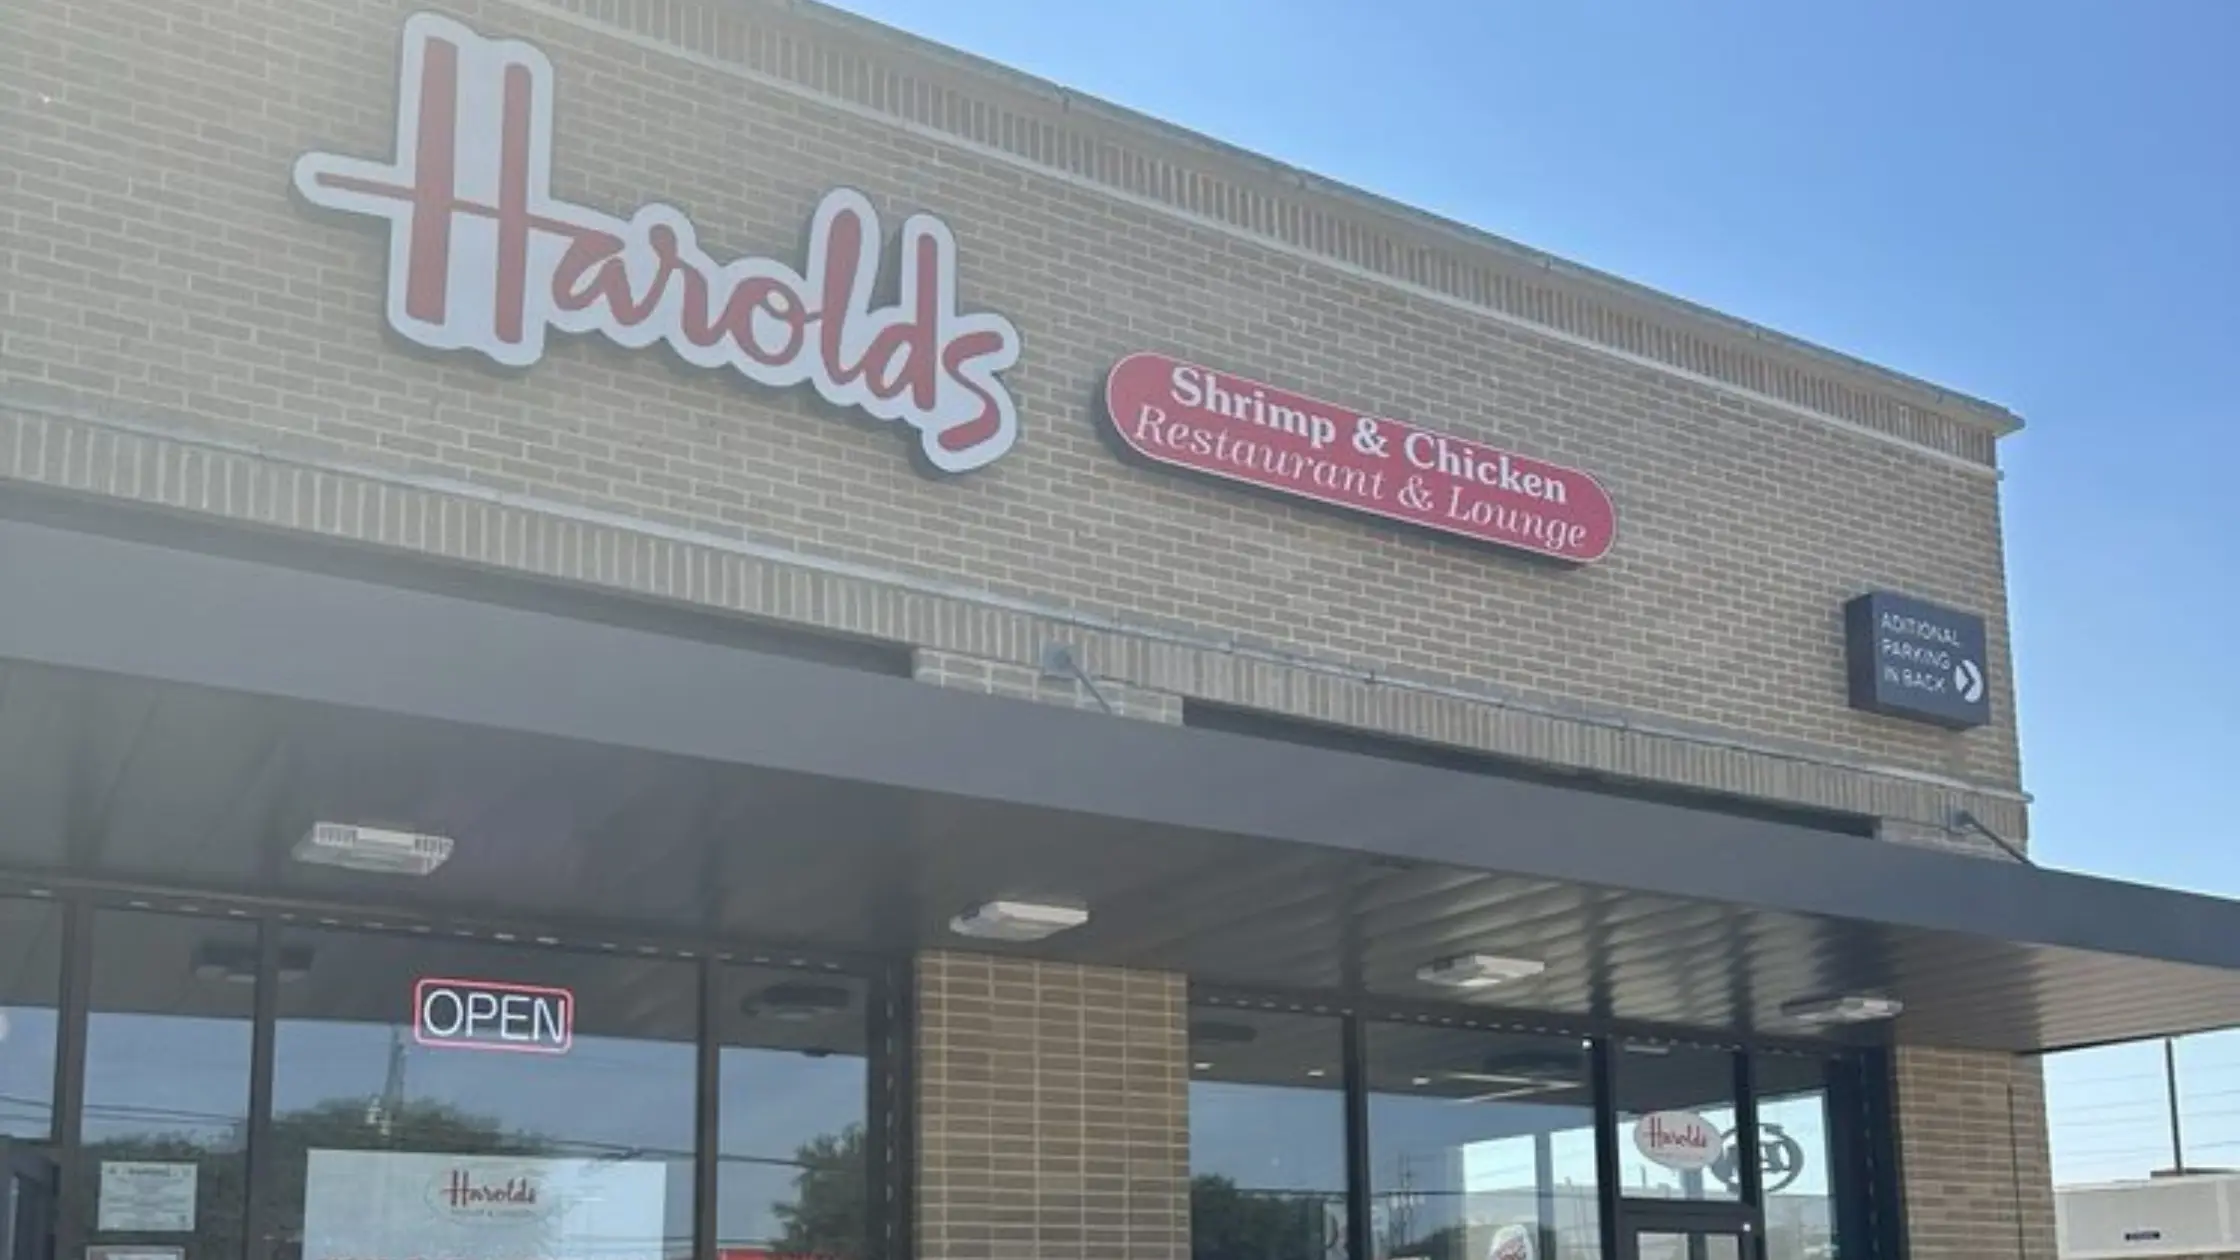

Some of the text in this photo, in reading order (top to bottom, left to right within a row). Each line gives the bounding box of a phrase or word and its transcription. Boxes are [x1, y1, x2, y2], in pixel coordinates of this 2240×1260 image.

[313, 35, 1005, 454] Harolds
[1169, 365, 1568, 505] Shrimp & Chicken
[1133, 402, 1588, 552] Restaurant & Lounge
[1881, 637, 1951, 671] PARKING
[1902, 668, 1947, 694] BACK
[423, 988, 566, 1044] OPEN
[1642, 1115, 1707, 1149] Harolds
[440, 1169, 537, 1208] Harolds
